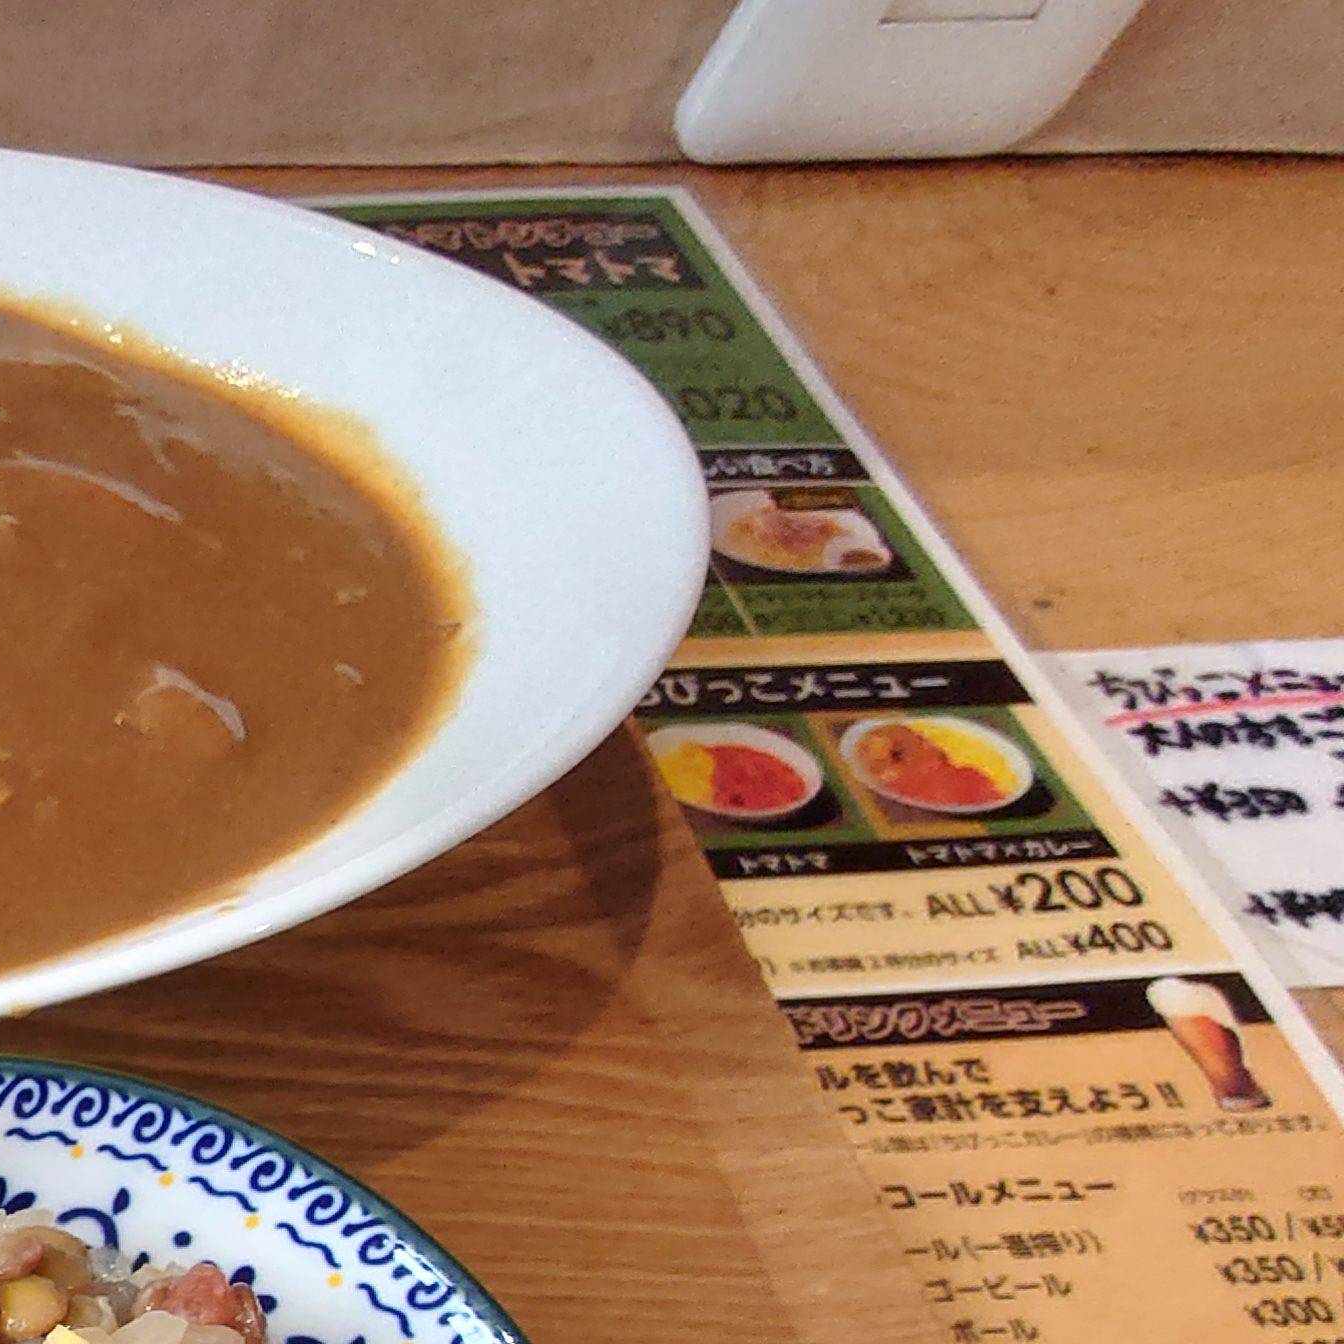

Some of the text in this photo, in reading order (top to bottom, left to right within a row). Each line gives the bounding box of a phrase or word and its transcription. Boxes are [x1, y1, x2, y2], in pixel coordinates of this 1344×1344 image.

[674, 383, 797, 421] 020
[736, 852, 830, 875] トマトマ
[880, 1178, 1116, 1210] コールメニュー
